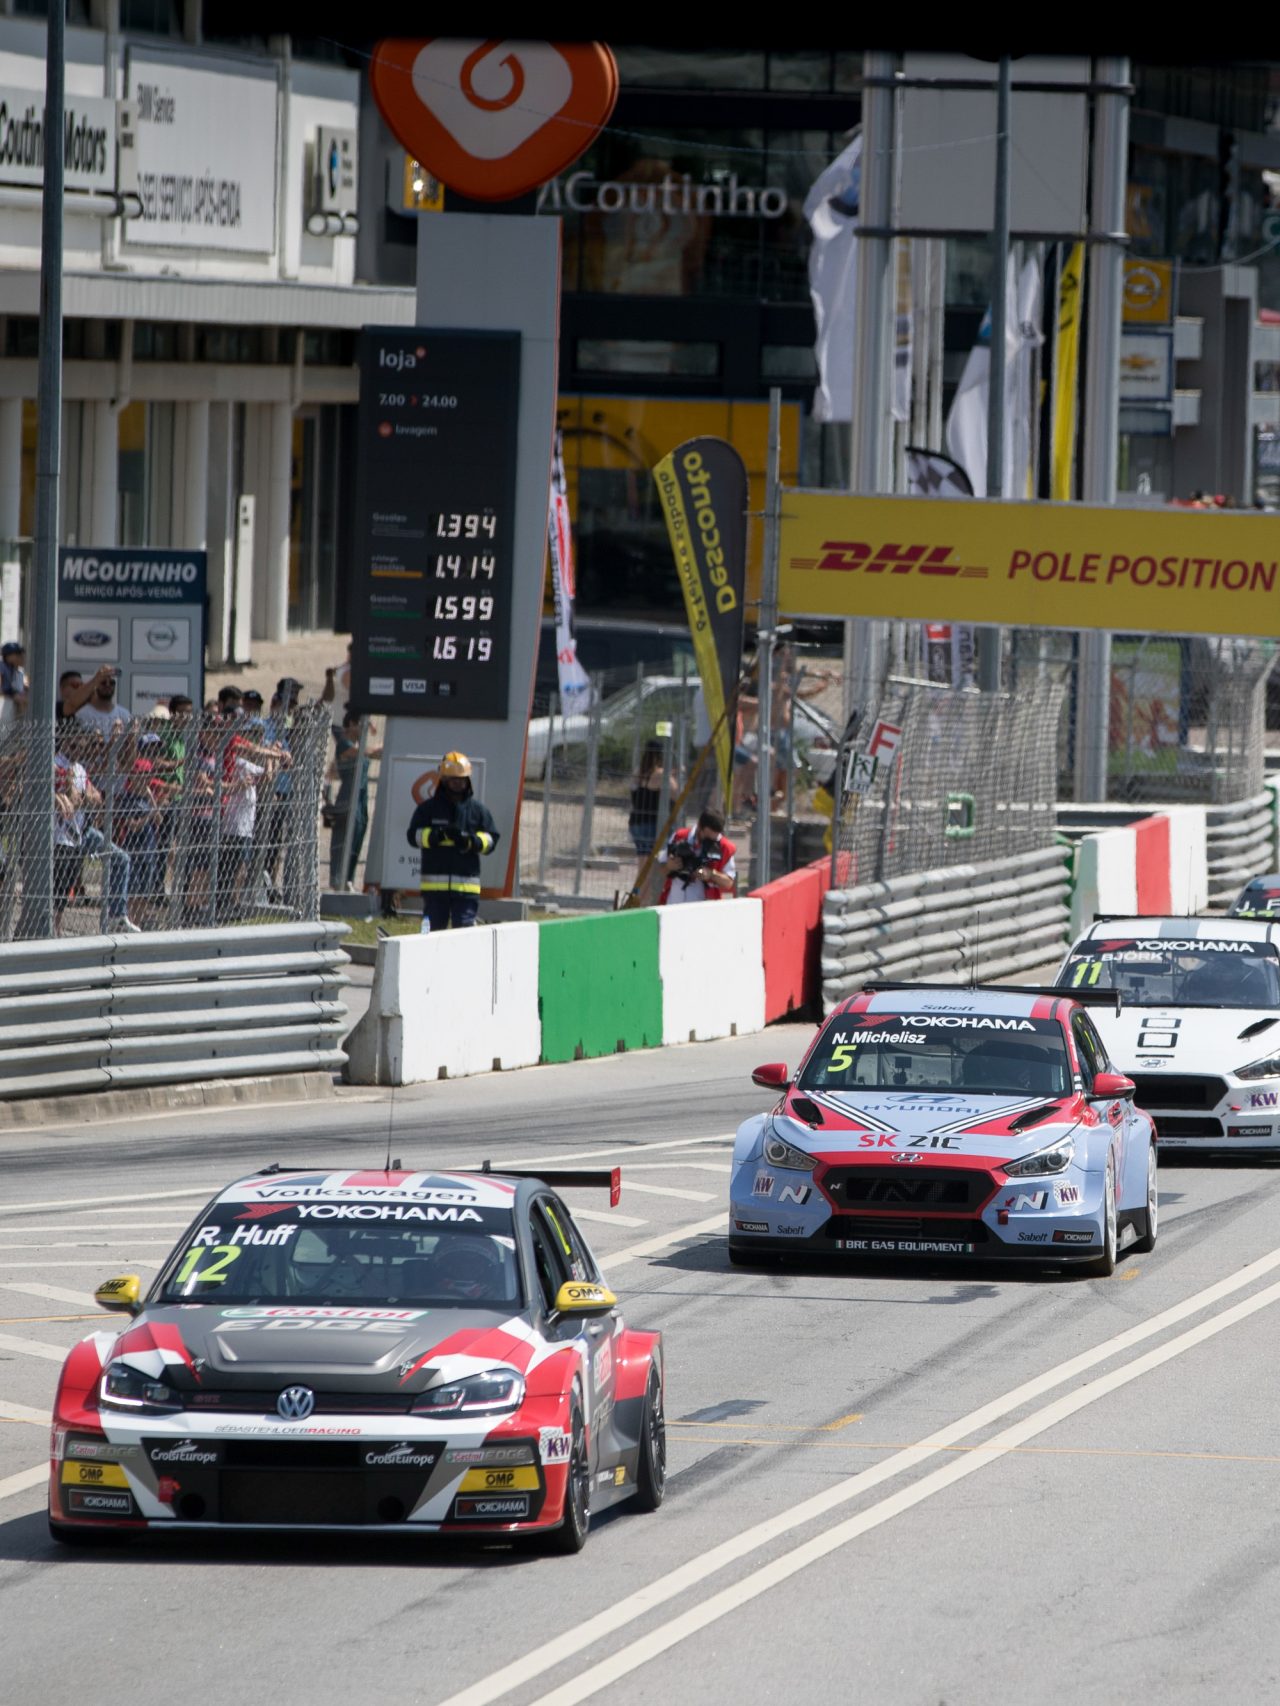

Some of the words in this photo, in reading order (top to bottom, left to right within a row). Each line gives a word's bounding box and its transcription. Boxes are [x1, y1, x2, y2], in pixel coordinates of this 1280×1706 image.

[379, 348, 416, 371] loja
[379, 394, 405, 406] 7.00
[422, 395, 458, 408] 24.00
[437, 514, 497, 539] 1.394
[817, 540, 962, 577] DHL
[1007, 549, 1103, 584] POLE
[1105, 554, 1278, 592] POSITION
[434, 595, 494, 620] 1.599
[404, 681, 426, 691] VISA
[869, 722, 902, 756] F
[1235, 901, 1255, 914] J.
[1135, 940, 1255, 953] YOKOHAMA
[1101, 949, 1164, 961] BJÖRK
[1072, 961, 1103, 987] 11
[921, 1004, 975, 1012] Sabelt
[900, 1016, 1036, 1031] YOKOHAMA
[832, 1032, 849, 1045] N.
[852, 1030, 927, 1044] Michelisz
[827, 1045, 857, 1073] 5
[1250, 1092, 1279, 1107] KW
[863, 1105, 980, 1113] HYUNDAI
[858, 1134, 897, 1148] SK
[909, 1135, 963, 1149] ZIC
[755, 1177, 774, 1192] KW
[256, 1187, 478, 1202] Volkswagen
[1060, 1188, 1080, 1202] KW
[297, 1204, 484, 1222] YOKOHAMA
[742, 1223, 768, 1231] YOKOHAMA
[777, 1225, 804, 1235] Sabelt
[192, 1226, 222, 1247] R.
[229, 1224, 298, 1247] Huff
[1017, 1232, 1048, 1242] Sabelt
[1063, 1233, 1092, 1241] YOKOHAMA
[846, 1240, 869, 1250] BRC
[871, 1241, 895, 1250] GAS
[898, 1241, 964, 1252] EQUIPMENT
[176, 1245, 242, 1285] 12
[98, 1280, 127, 1291] OMP
[264, 1308, 414, 1319] Castrol
[211, 1319, 418, 1333] EDGE
[100, 1447, 138, 1458] EDGE
[485, 1449, 527, 1461] EDGE
[546, 1438, 571, 1458] KW
[150, 1448, 217, 1463] CroisiEurope
[365, 1450, 434, 1467] CroisiEurope
[79, 1467, 103, 1482] OMP
[485, 1473, 514, 1486] OMP
[83, 1496, 128, 1509] YOKOHAMA
[475, 1501, 525, 1513] YOKOHAMA
